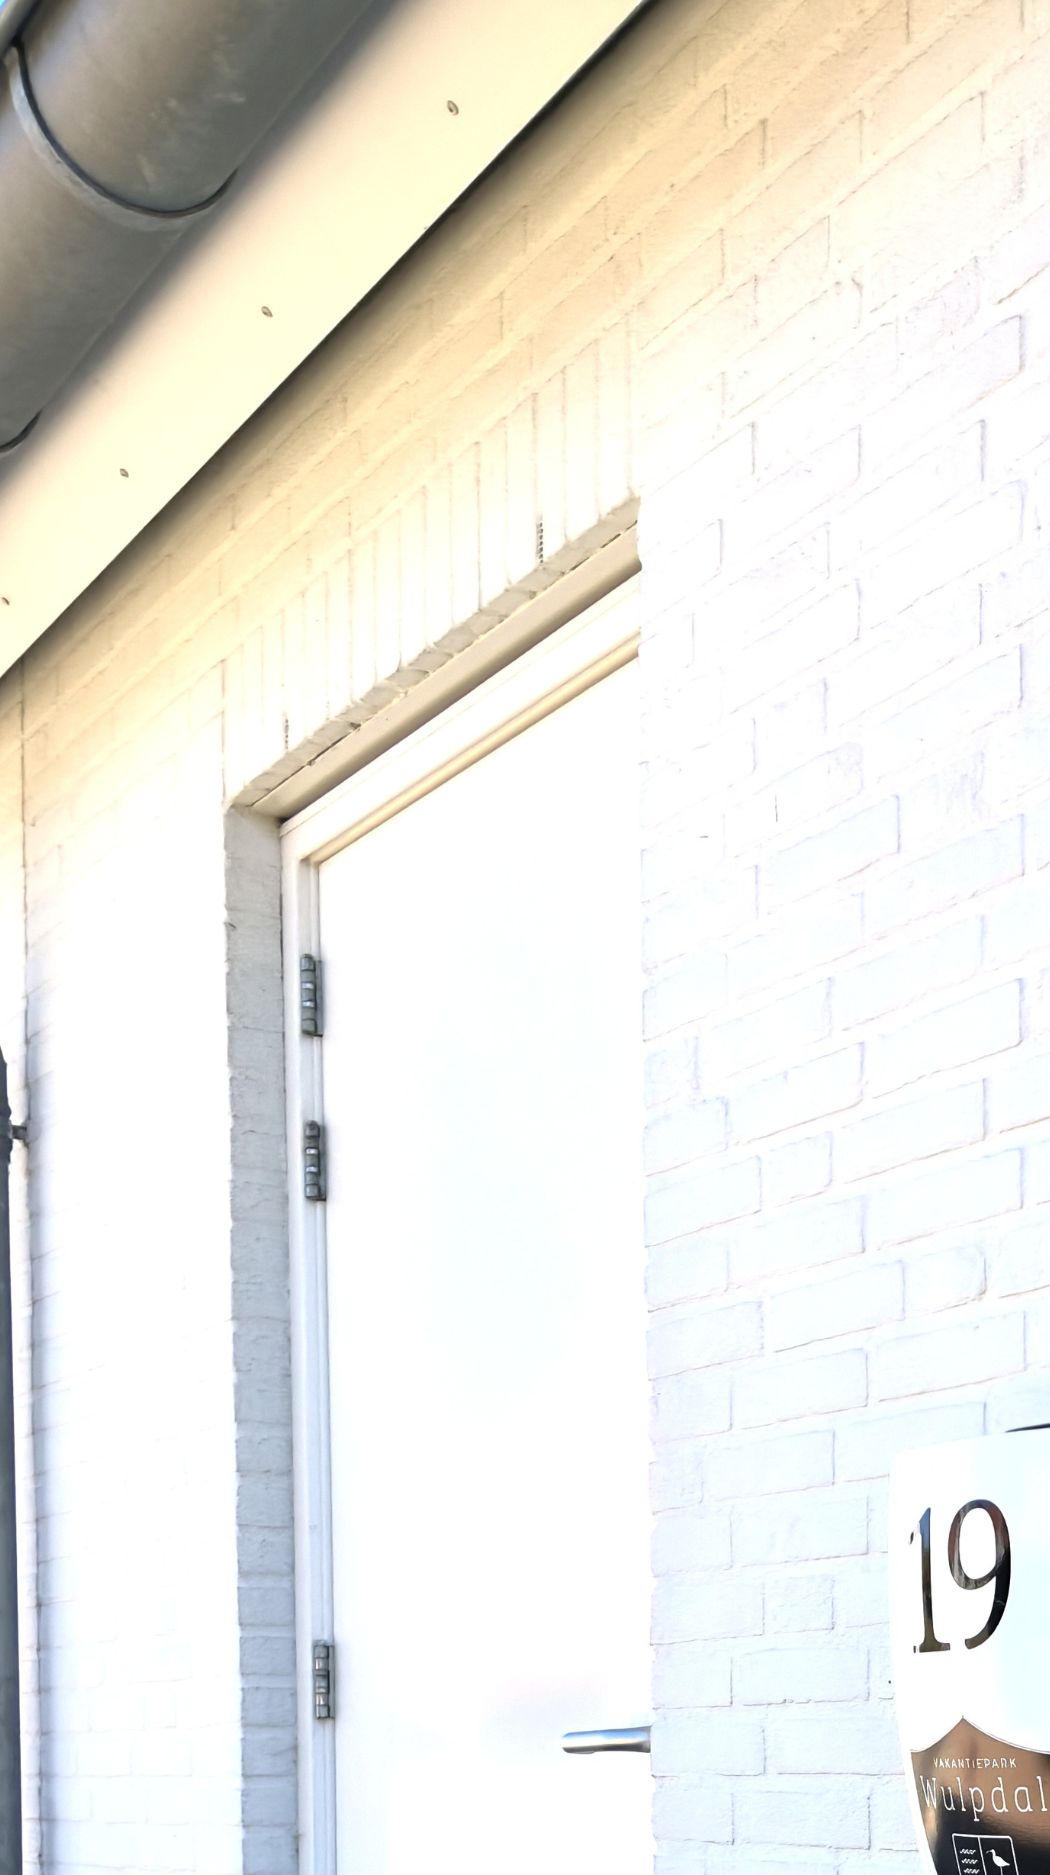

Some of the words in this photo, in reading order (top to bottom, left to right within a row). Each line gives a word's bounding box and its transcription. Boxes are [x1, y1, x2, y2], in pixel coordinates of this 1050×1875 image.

[908, 1499, 1011, 1653] 19
[933, 1757, 1017, 1769] VAKANTIEPARK
[919, 1775, 1048, 1822] Wulpdal
